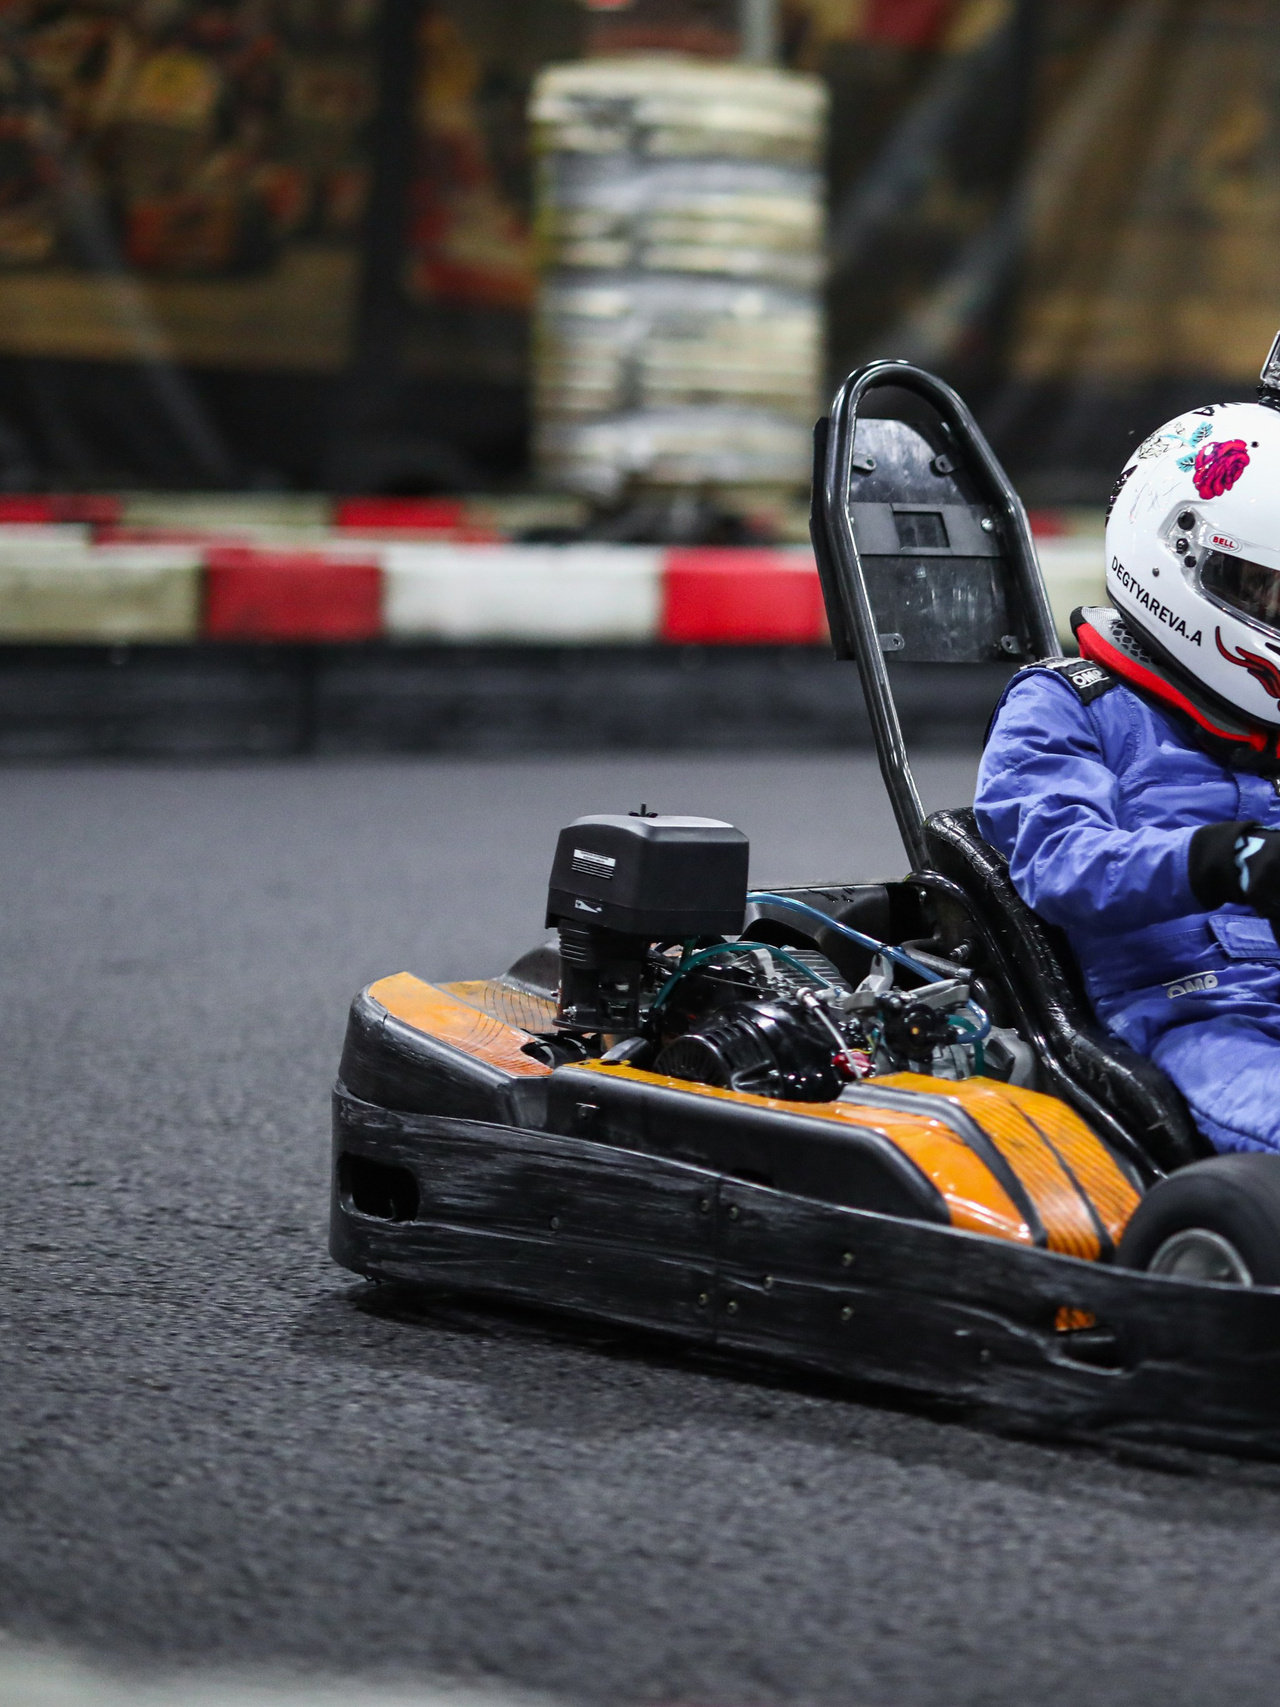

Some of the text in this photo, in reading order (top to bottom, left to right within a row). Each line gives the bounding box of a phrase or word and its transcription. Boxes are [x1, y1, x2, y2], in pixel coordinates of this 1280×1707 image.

[1212, 536, 1235, 548] BELL
[1111, 555, 1202, 647] DEGTYAREVA.A
[1072, 669, 1103, 686] OMP
